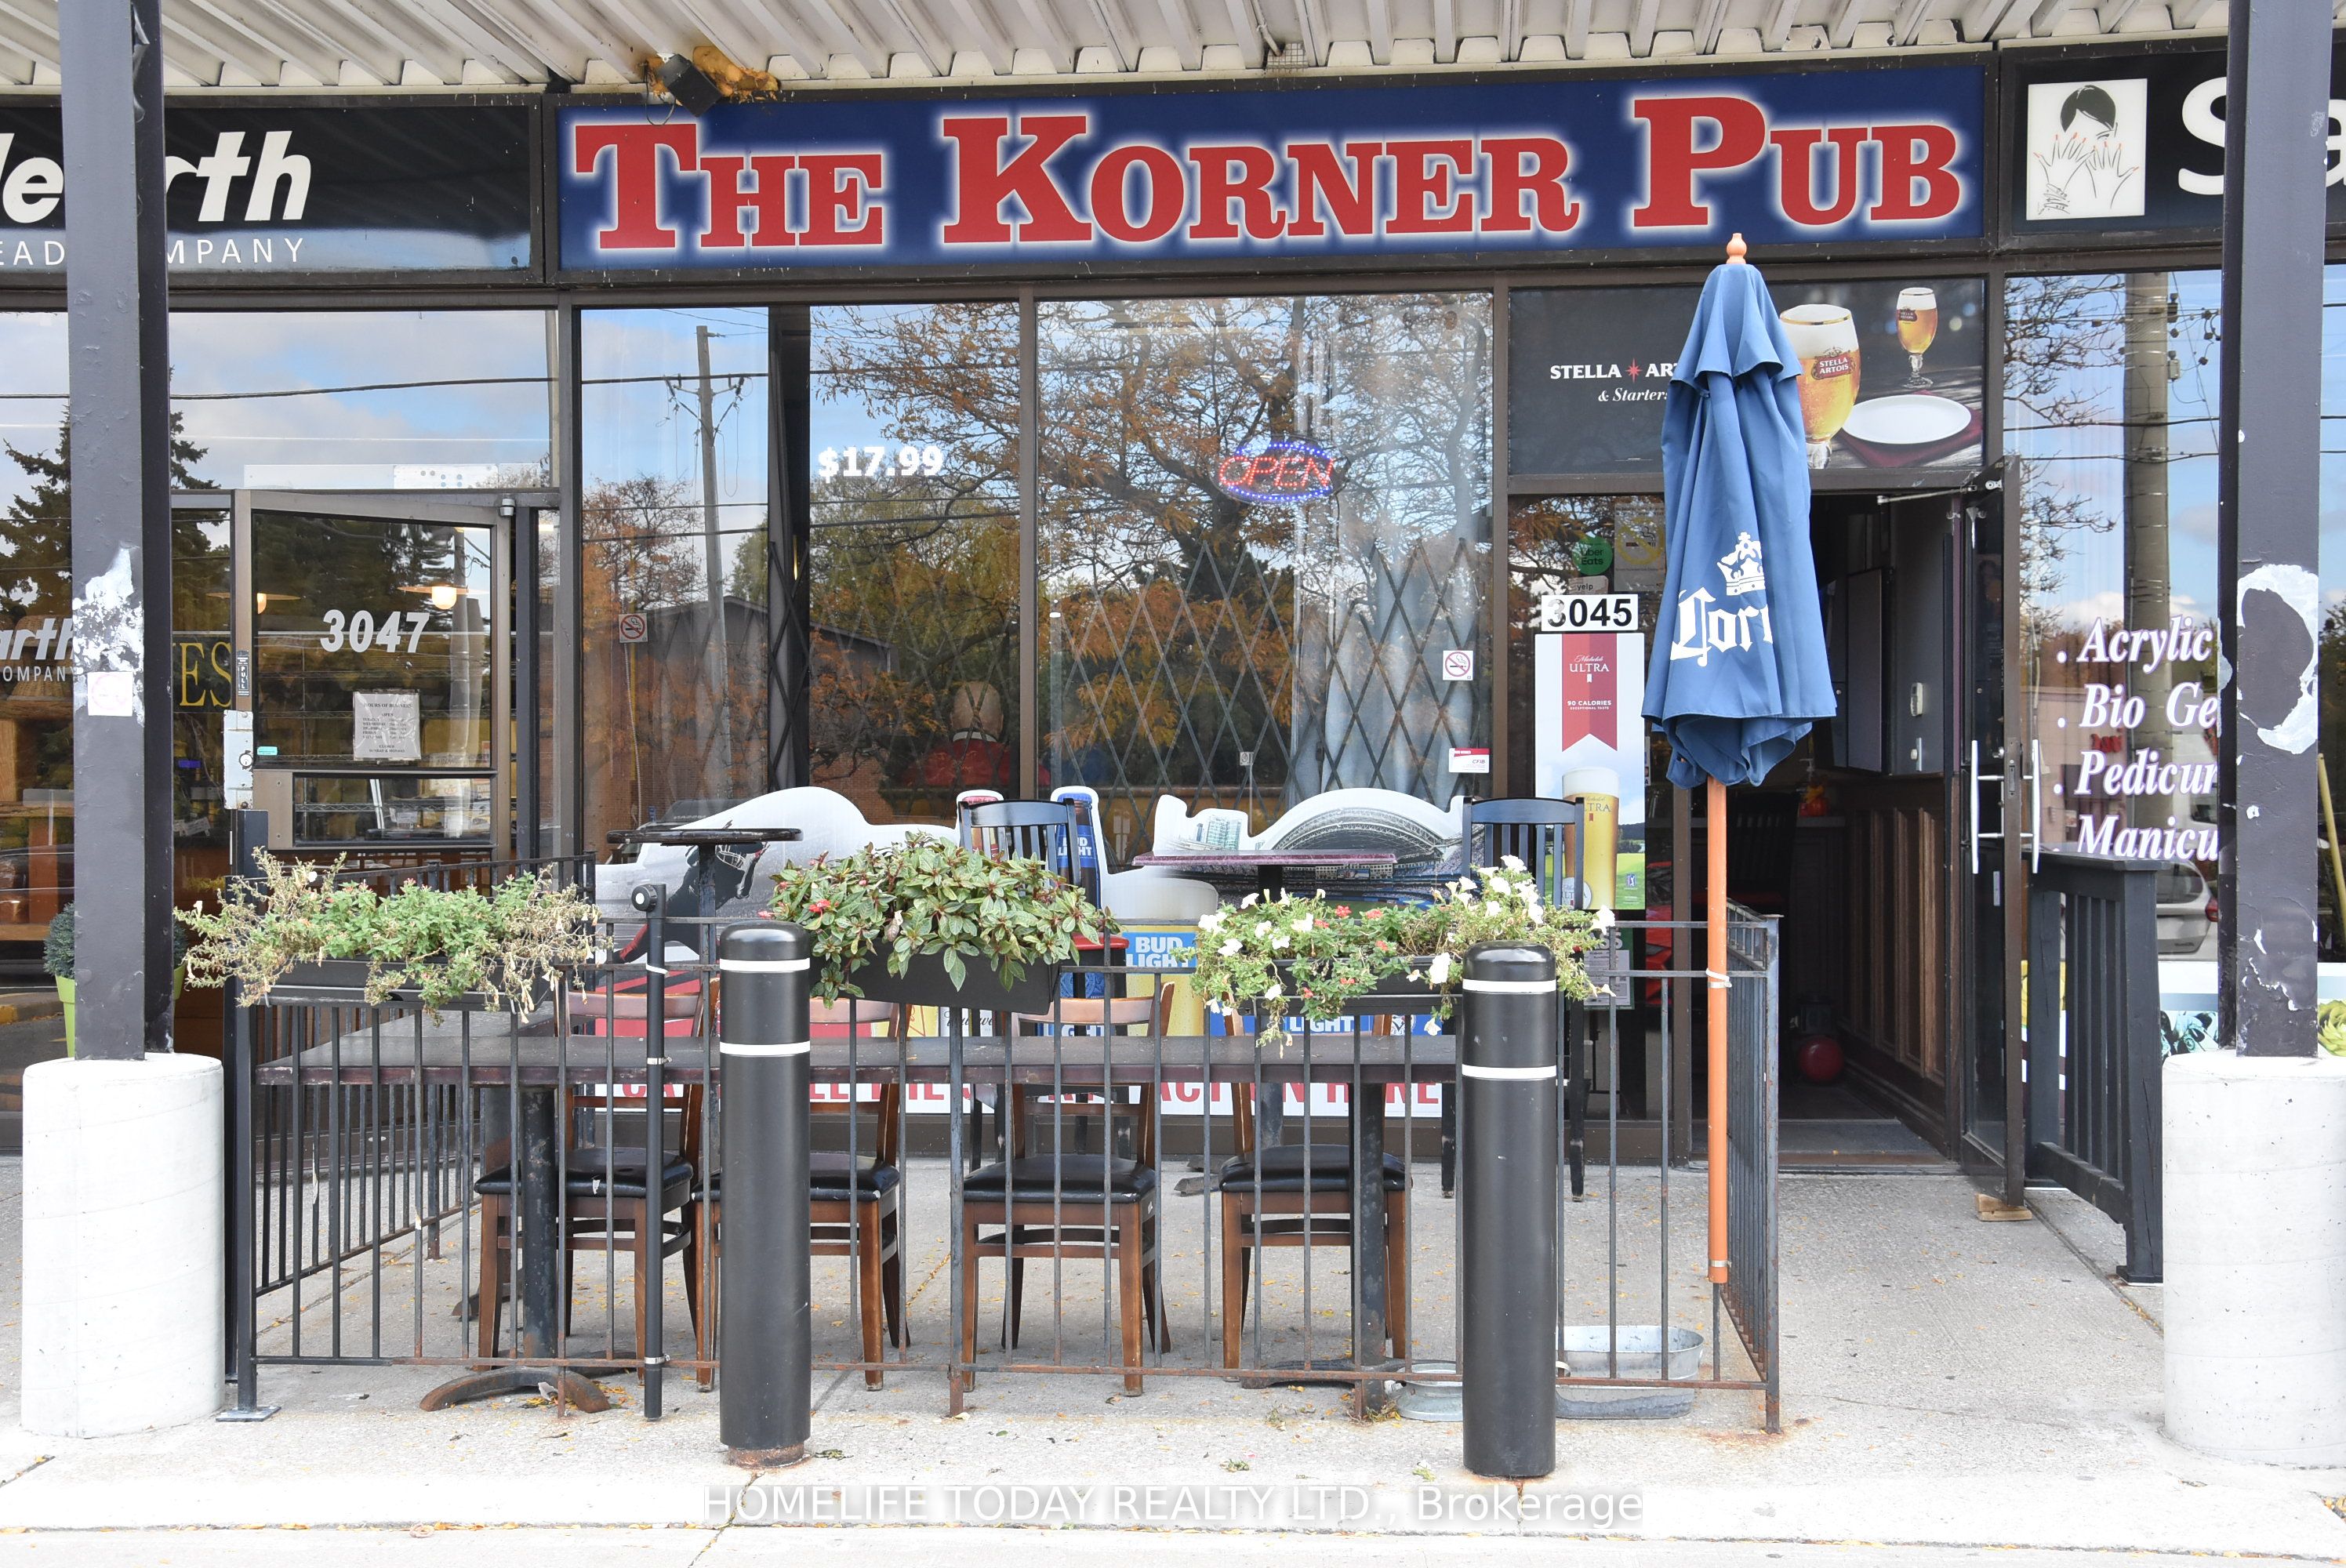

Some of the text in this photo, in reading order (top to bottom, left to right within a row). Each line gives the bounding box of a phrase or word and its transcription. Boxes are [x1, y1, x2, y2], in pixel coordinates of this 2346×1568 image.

[574, 96, 1961, 249] THE KORNER PUB
[1550, 364, 1622, 379] STELLA
[1819, 357, 1848, 368] STELLA
[1819, 363, 1849, 374] ARTOIS
[1598, 390, 1609, 402] &
[818, 446, 943, 484] $17.99
[1218, 456, 1335, 488] OPEN
[1547, 598, 1632, 627] 3045
[320, 609, 430, 652] 3047
[2075, 614, 2214, 674] Acrylic
[1569, 663, 1610, 673] ULTRA
[2079, 683, 2145, 728] Bio
[1135, 936, 1183, 953] BUD
